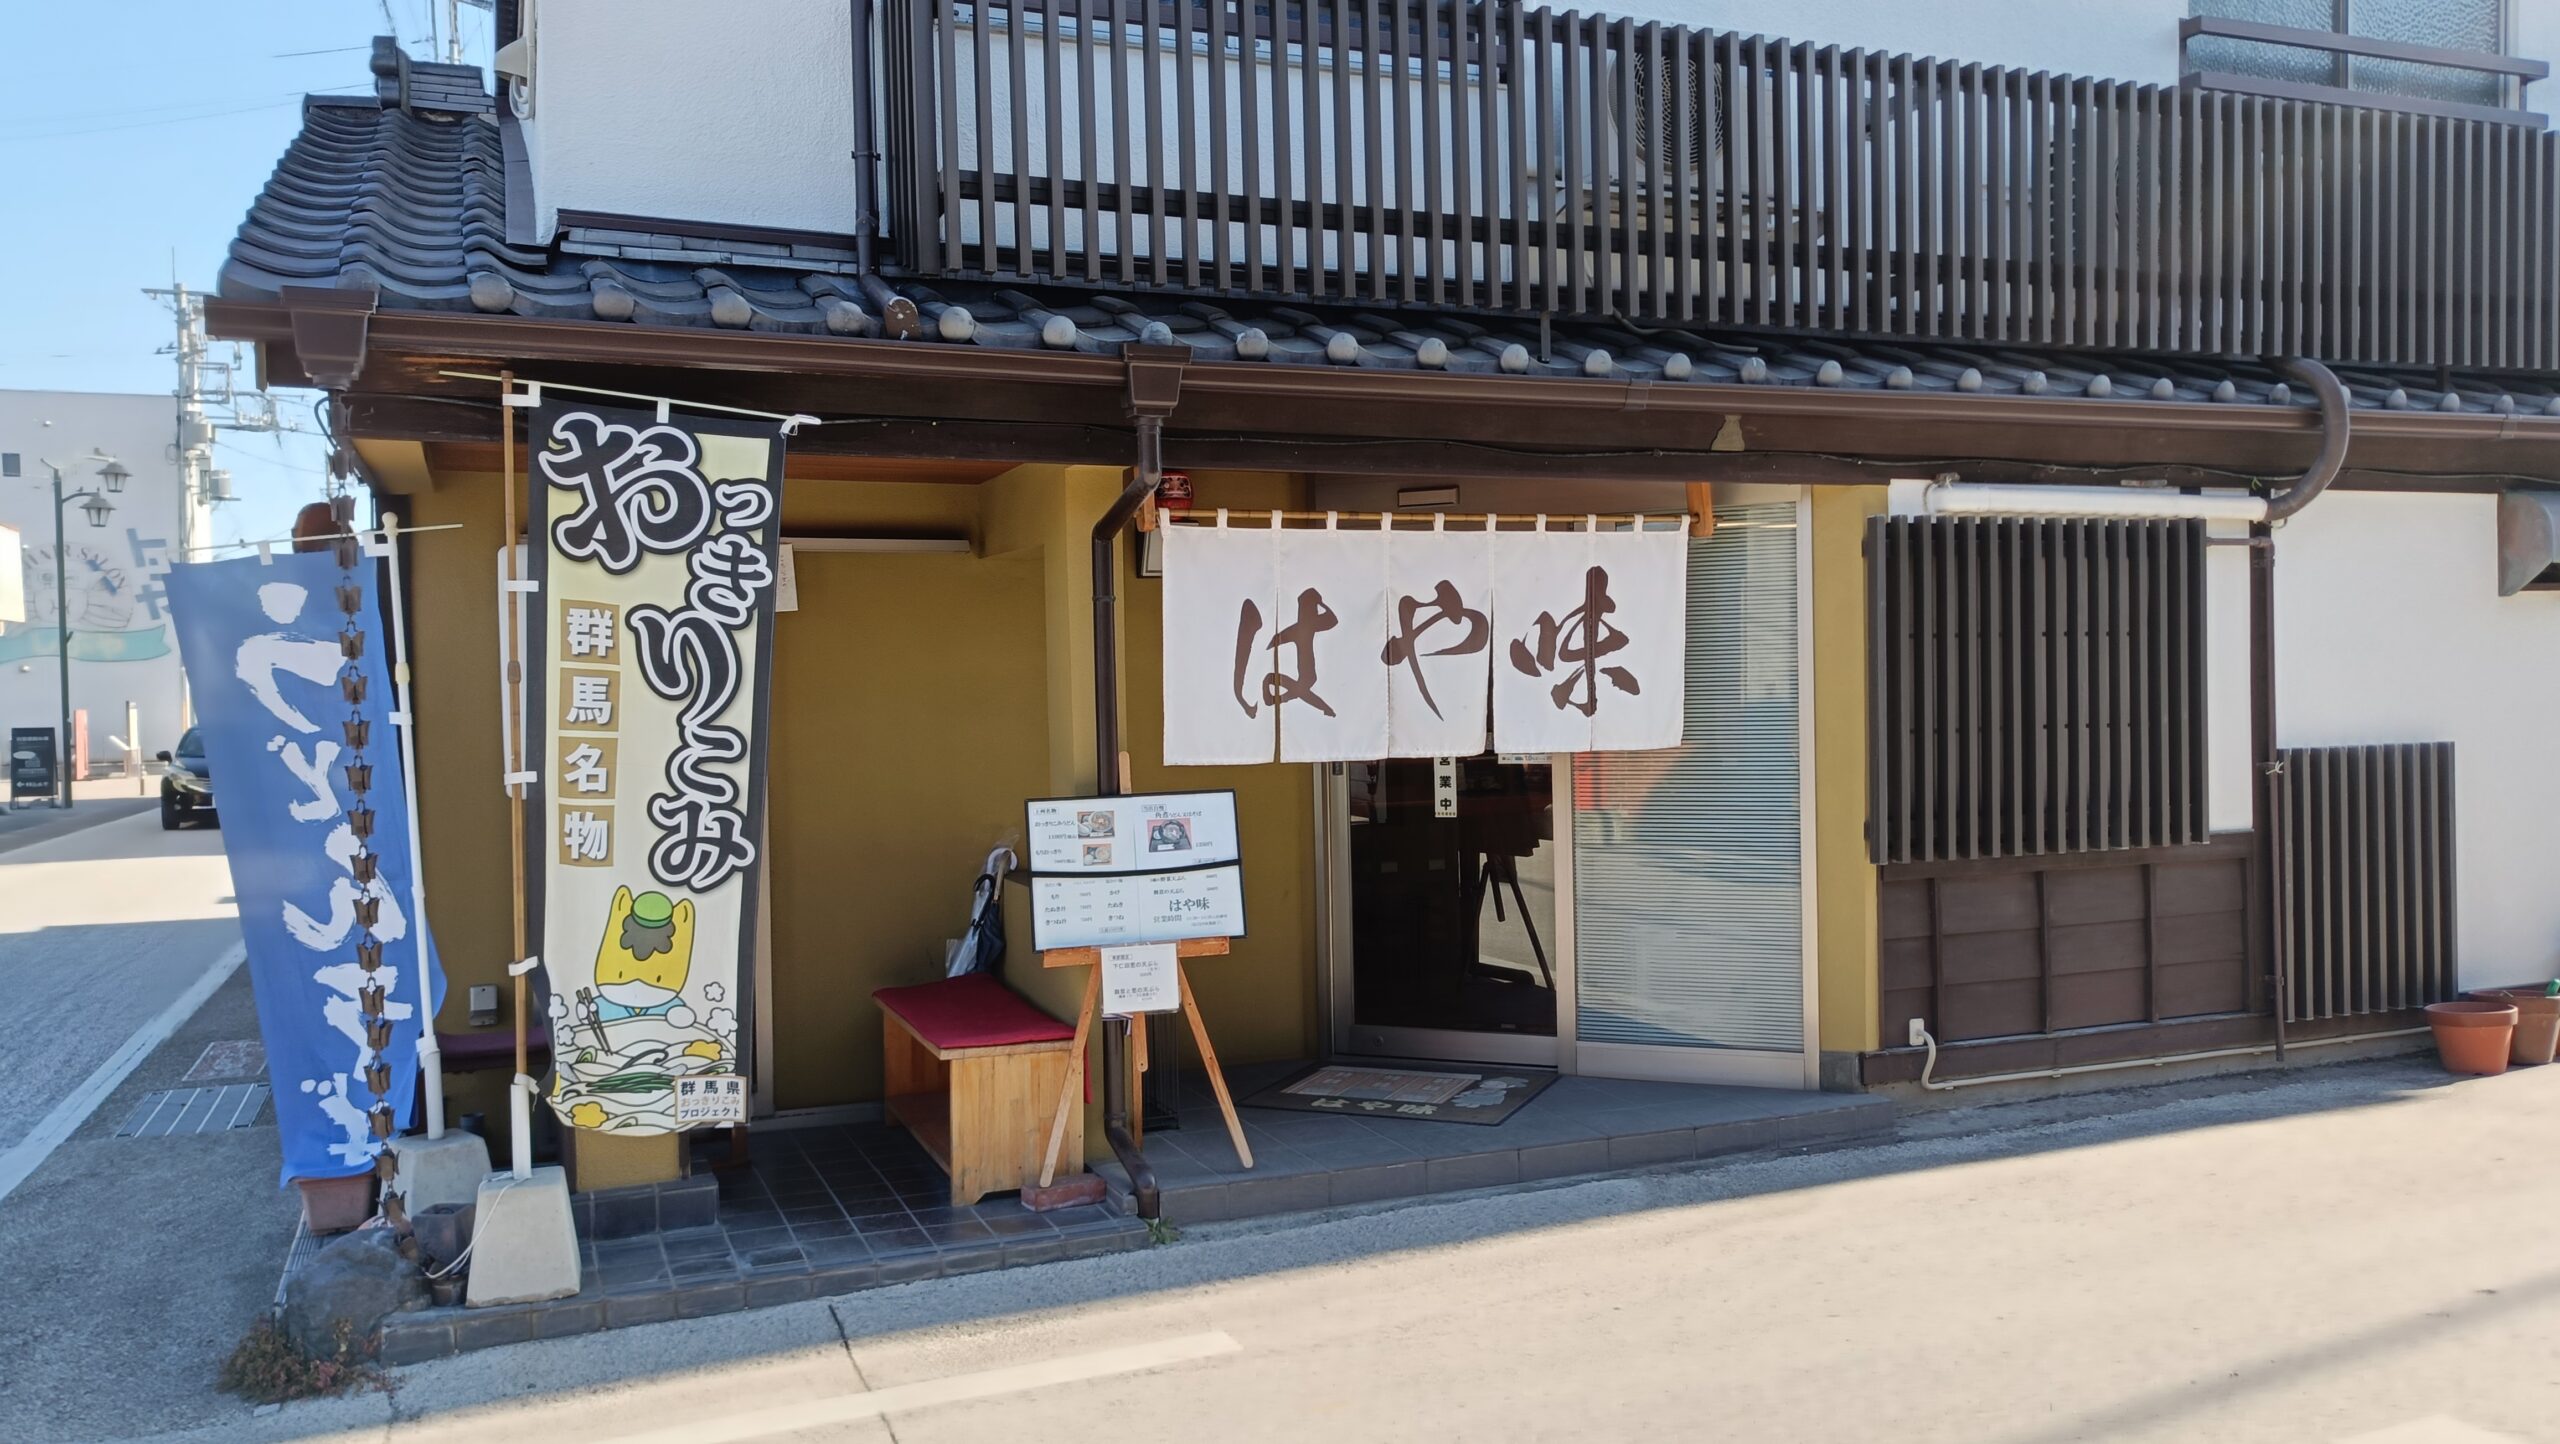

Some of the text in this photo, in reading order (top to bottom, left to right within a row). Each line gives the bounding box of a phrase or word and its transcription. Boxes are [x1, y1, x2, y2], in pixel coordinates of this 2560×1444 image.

[1233, 565, 1641, 722] はや味
[561, 606, 616, 862] 群馬名物
[1169, 897, 1210, 912] はや味
[680, 1080, 741, 1096] 群馬県
[681, 1096, 740, 1108] おっきりこみ
[680, 1107, 741, 1119] プロジェクト
